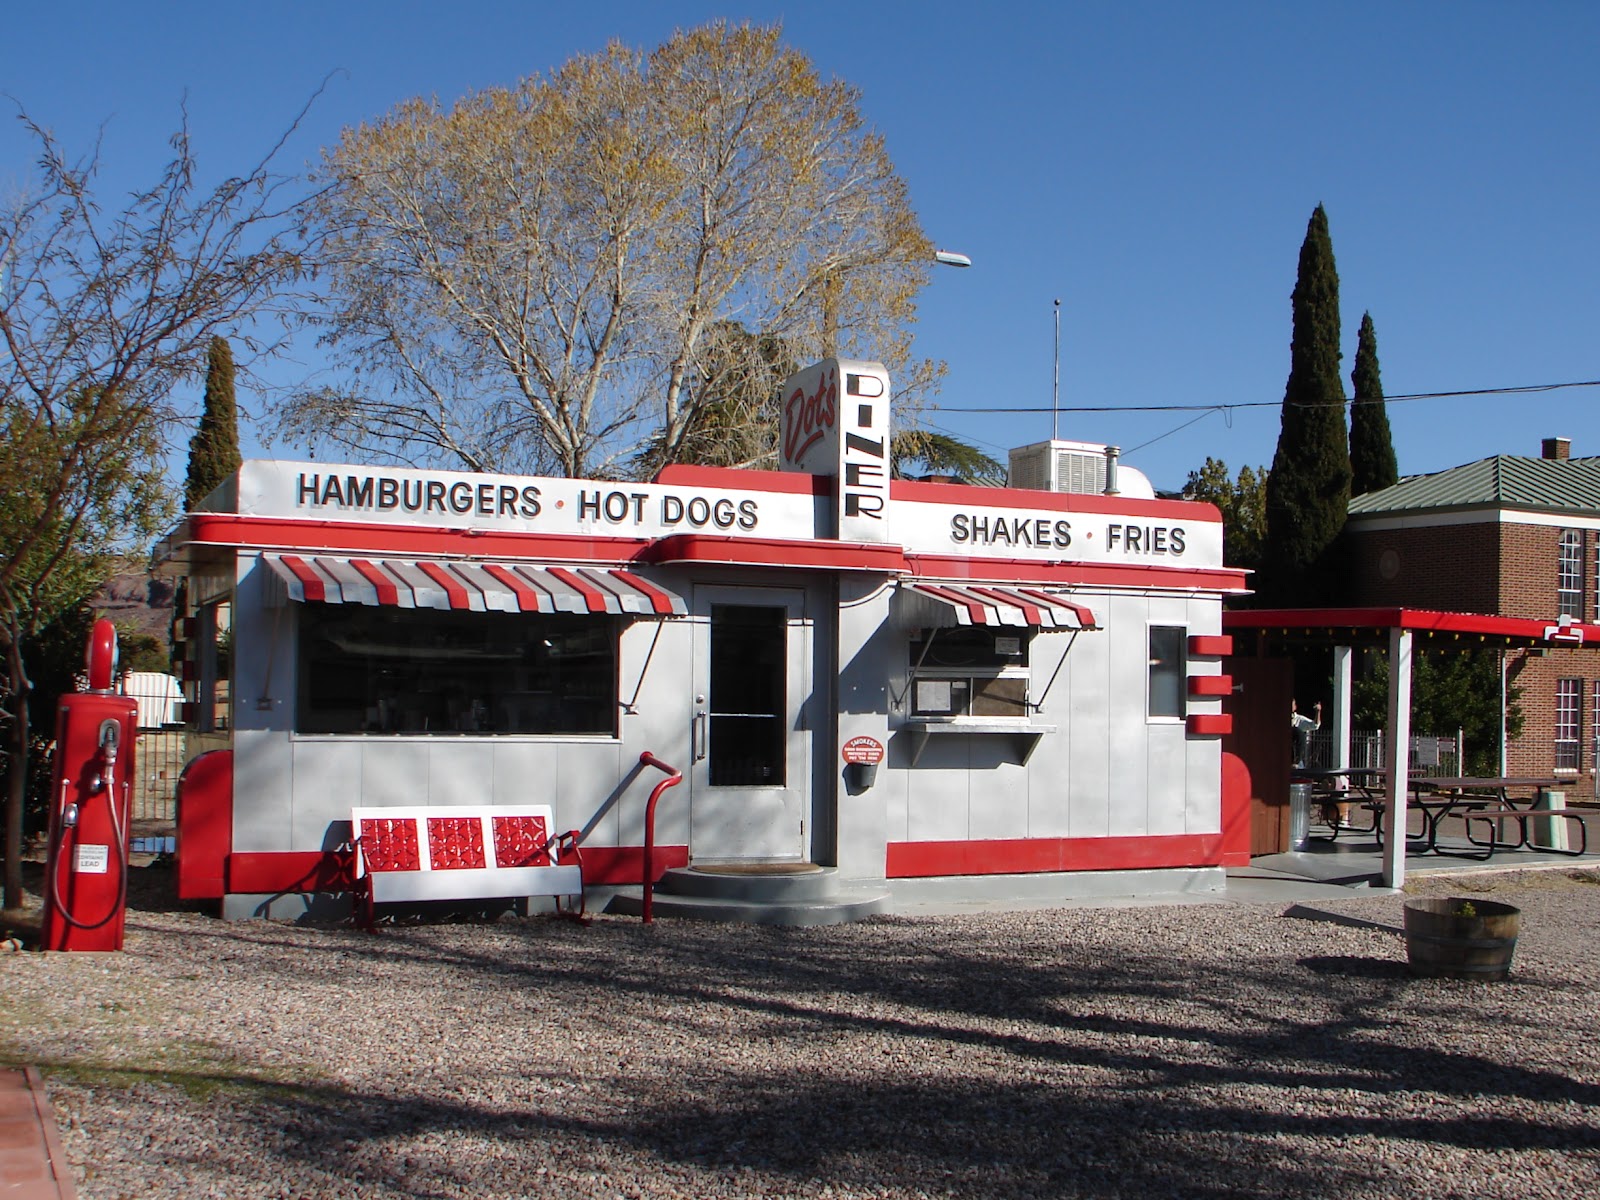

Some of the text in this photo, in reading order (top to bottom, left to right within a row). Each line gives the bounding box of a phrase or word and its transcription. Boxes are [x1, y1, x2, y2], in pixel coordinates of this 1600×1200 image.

[785, 367, 837, 462] Dot's
[845, 373, 884, 520] DINER
[297, 472, 759, 532] HAMBURGERS HOT DOGS
[950, 513, 1187, 556] SHAKES FRIES
[851, 738, 877, 747] SMOKERS
